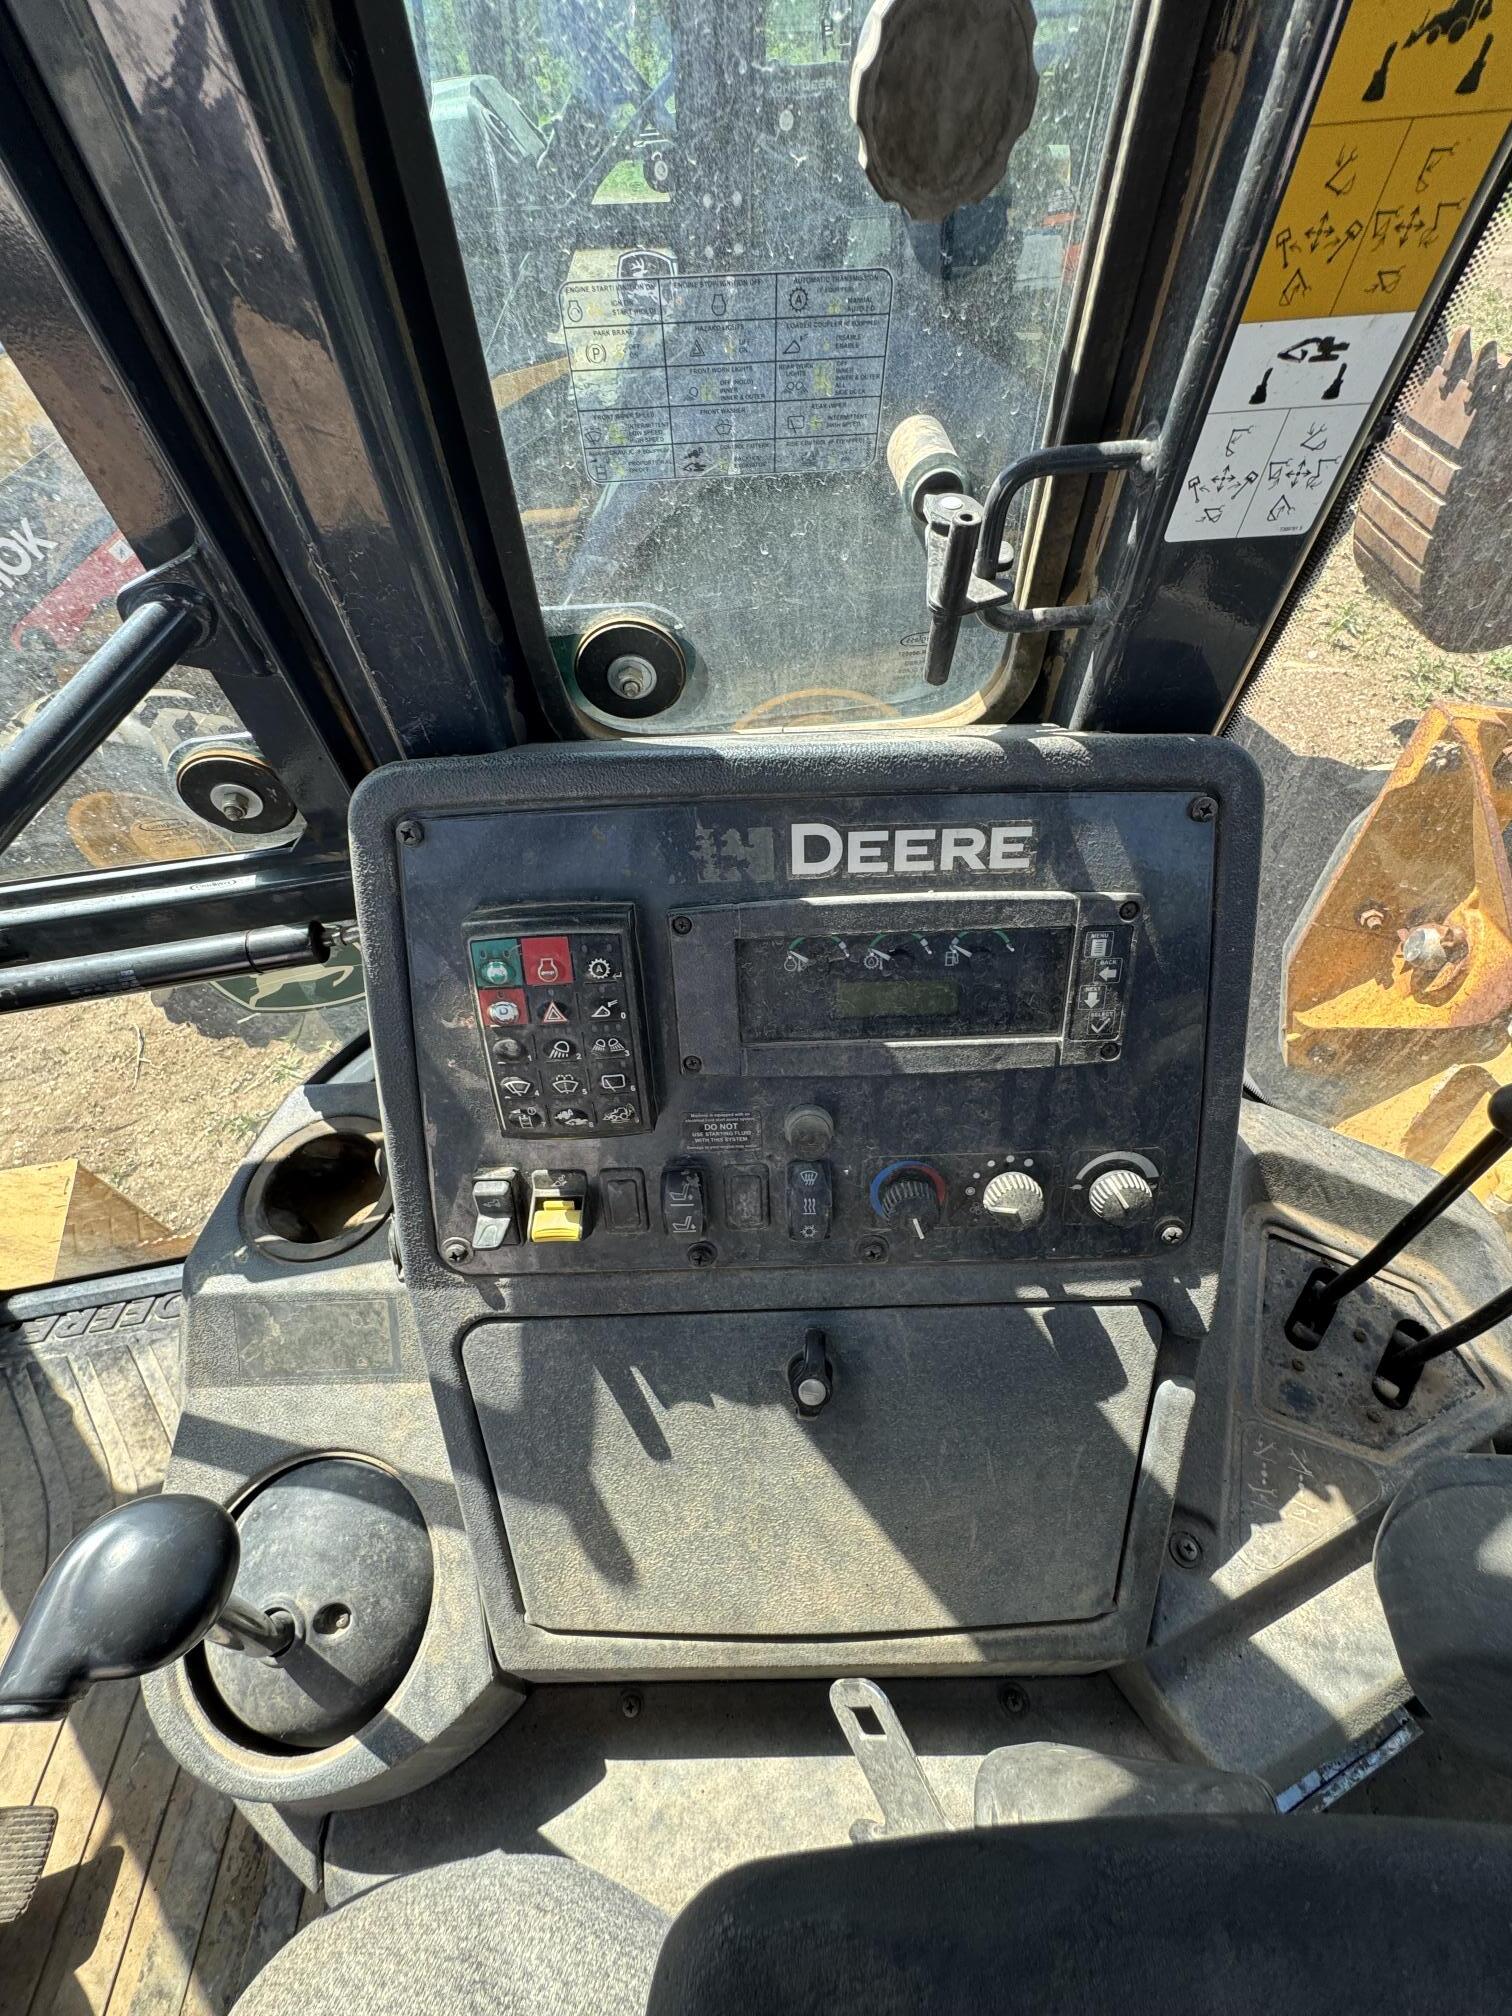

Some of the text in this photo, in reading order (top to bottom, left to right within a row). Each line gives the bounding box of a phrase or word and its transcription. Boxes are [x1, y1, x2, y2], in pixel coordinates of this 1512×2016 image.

[565, 285, 590, 294] ENGINE
[689, 367, 710, 375] FRONT
[791, 823, 1033, 875] DEERE
[596, 965, 603, 973] A
[704, 1122, 738, 1131] DO NOT
[18, 1291, 182, 1346] DEERE
